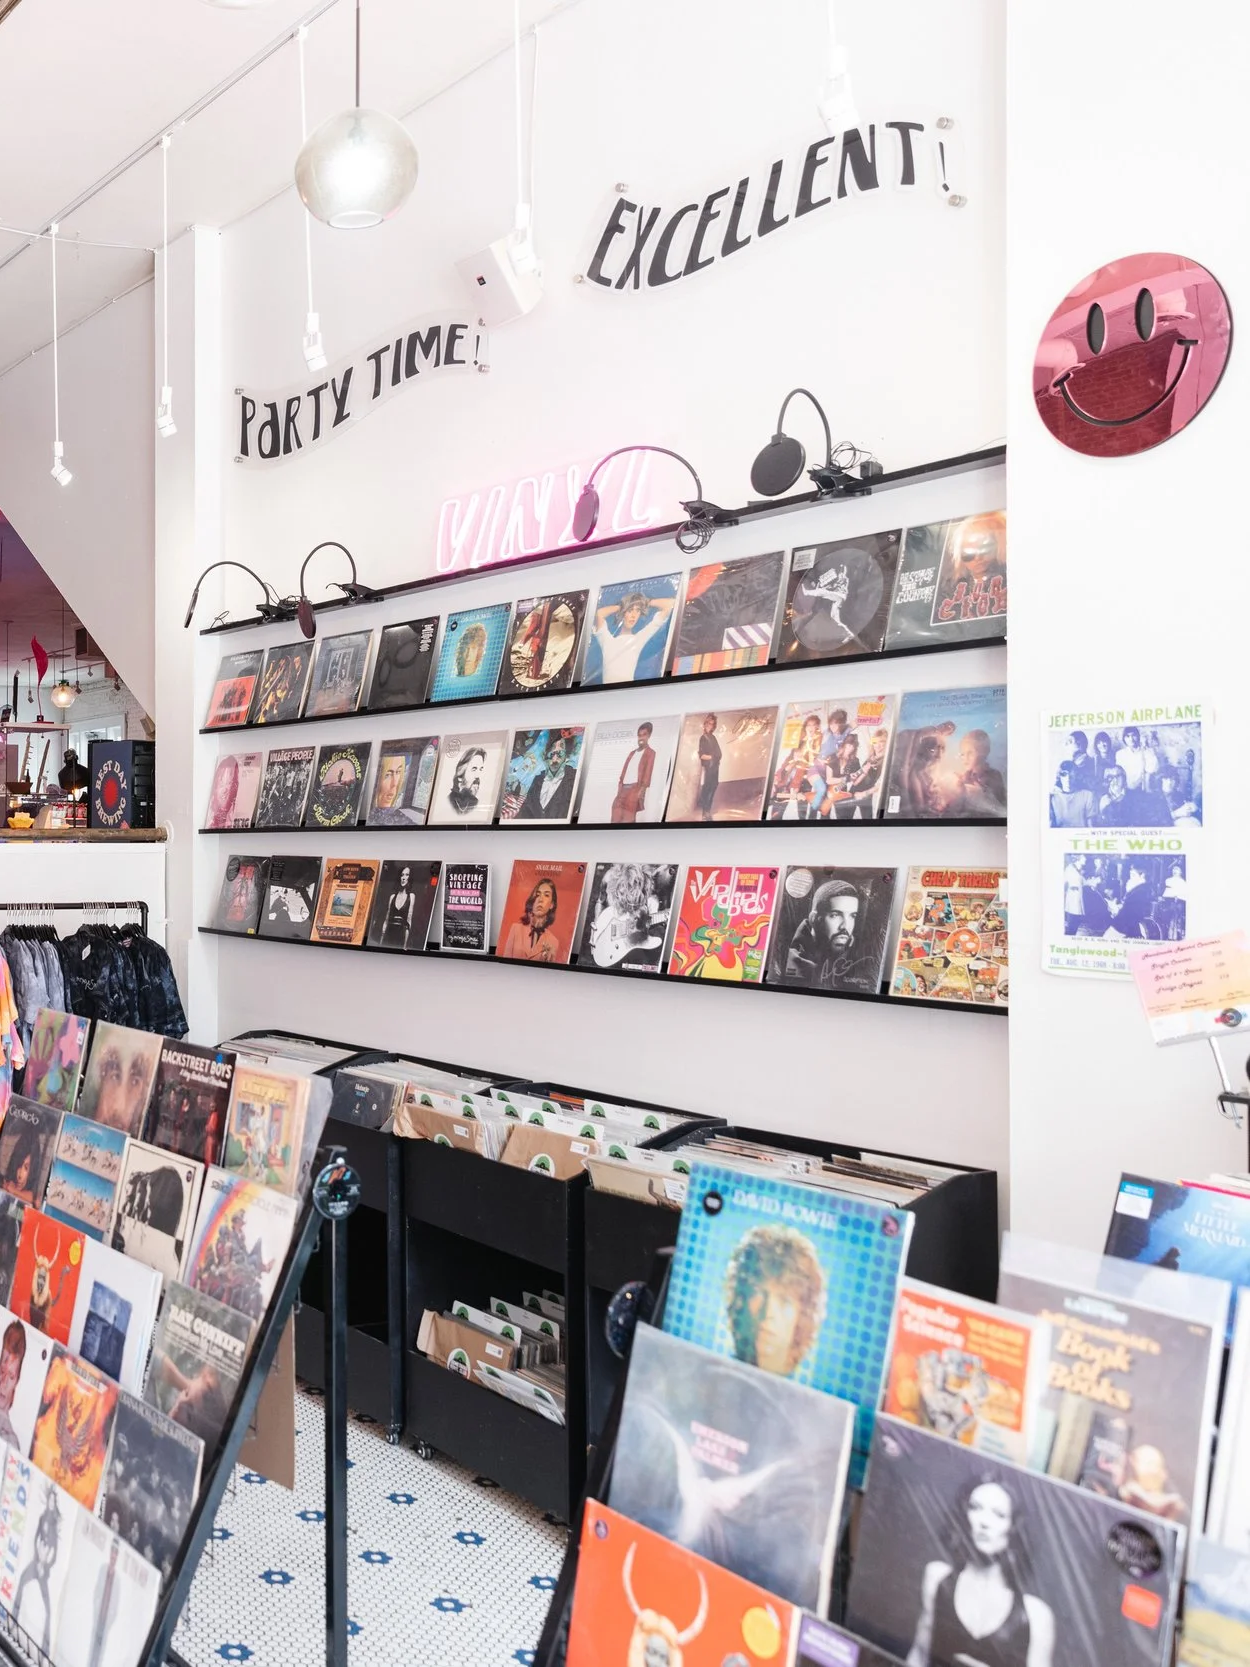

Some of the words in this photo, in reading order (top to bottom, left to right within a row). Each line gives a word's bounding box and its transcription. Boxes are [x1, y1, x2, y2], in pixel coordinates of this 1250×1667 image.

[586, 121, 950, 290] EXCELLENT!
[240, 366, 353, 459] PARTY
[367, 323, 480, 400] TIME!
[1048, 711, 1125, 728] JEFFERSON
[1131, 705, 1202, 722] AIRPLANE
[269, 750, 292, 762] VILLAGE
[291, 749, 314, 761] PEOPLE
[95, 760, 113, 791] BEST
[113, 761, 128, 790] DAY
[95, 797, 127, 826] BREWING
[1069, 839, 1118, 850] THE
[1126, 839, 1183, 851] WHO
[449, 873, 484, 882] SHOPPING
[449, 881, 482, 890] VINTAGE
[921, 870, 958, 888] CHEAP
[958, 871, 999, 889] THRILLS
[448, 896, 459, 904] THE
[460, 896, 483, 905] WORLD
[161, 1049, 211, 1074] BACKSTREET
[210, 1059, 233, 1079] BOYS
[733, 1189, 780, 1214] DAVID
[782, 1201, 837, 1229] BOWIE
[1194, 1211, 1238, 1233] LITTLE
[169, 1304, 195, 1330] RAY
[193, 1317, 246, 1357] CONNIFF
[1057, 1330, 1133, 1372] Book
[1072, 1358, 1105, 1380] of
[1049, 1361, 1132, 1410] Books
